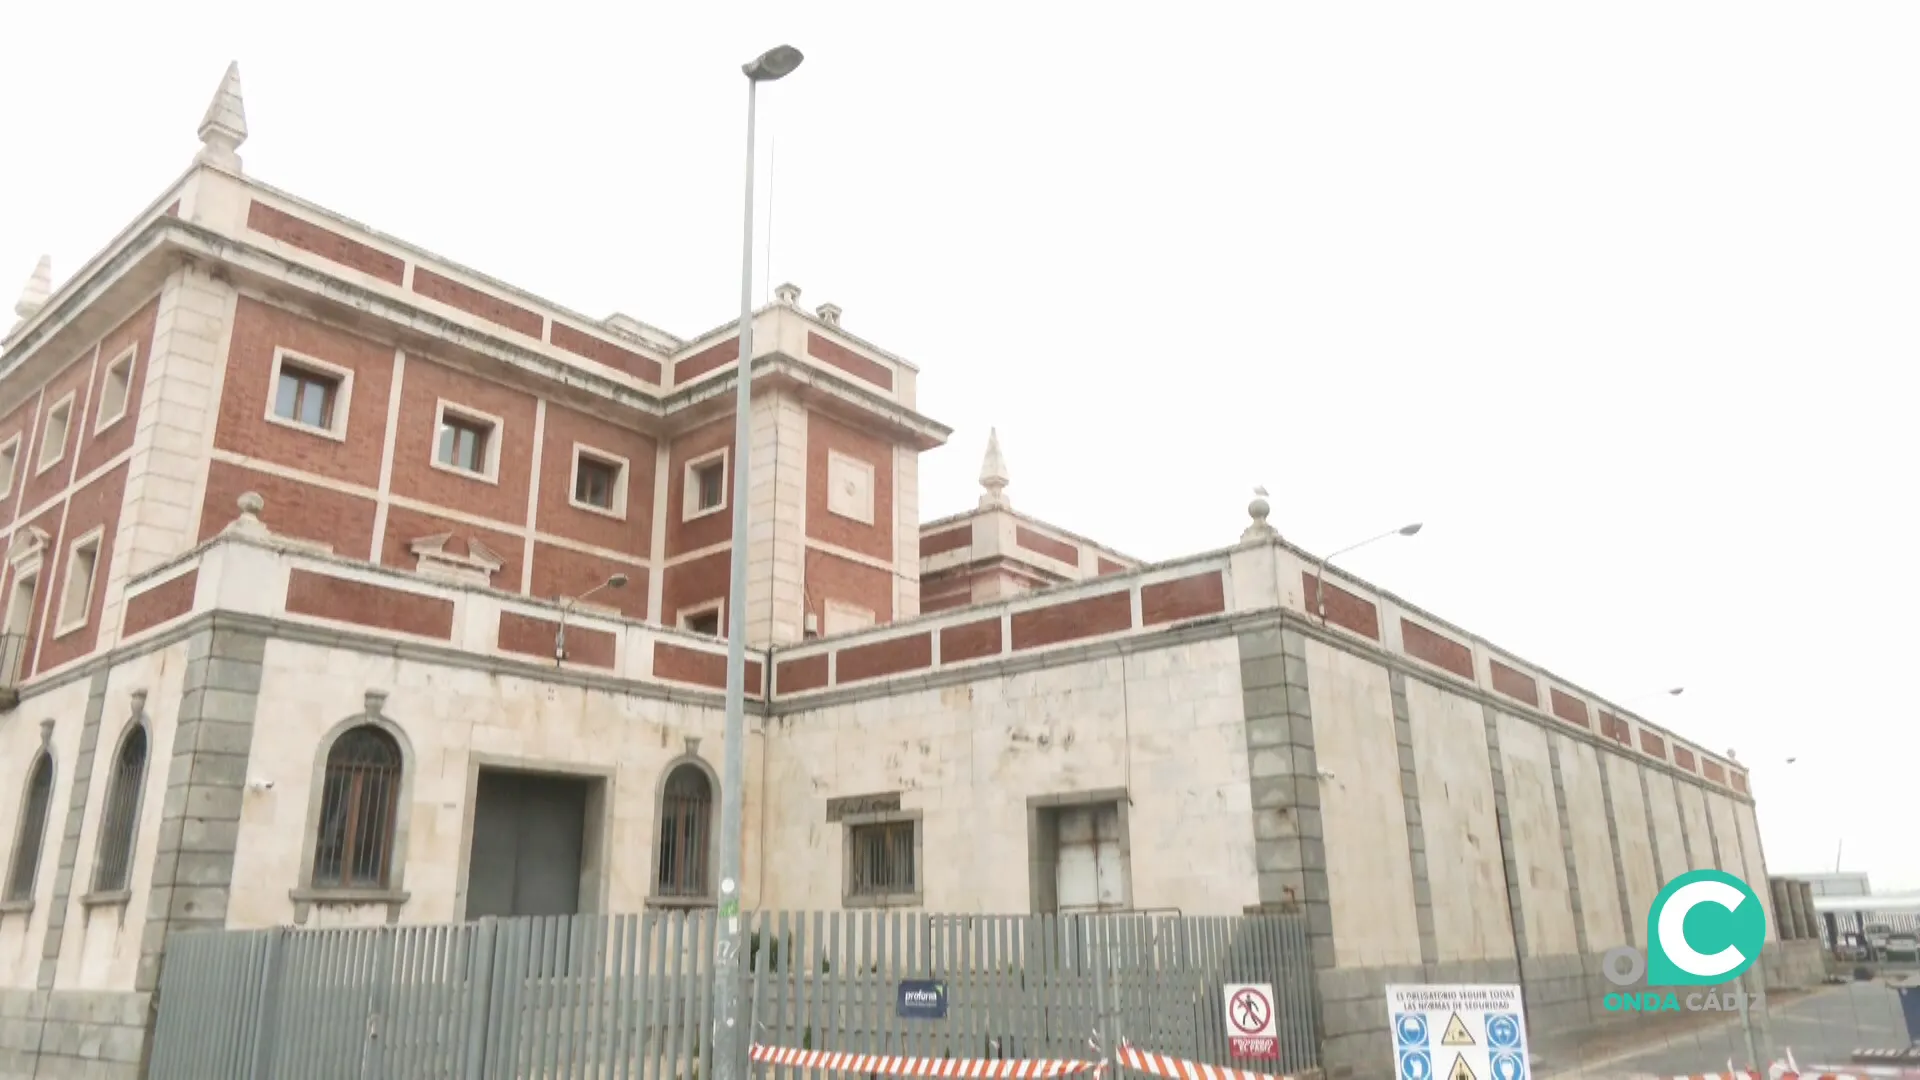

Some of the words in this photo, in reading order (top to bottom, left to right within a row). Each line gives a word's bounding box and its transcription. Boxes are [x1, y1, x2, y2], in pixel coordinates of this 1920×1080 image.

[1396, 992, 1404, 1000] ES
[1406, 991, 1456, 1000] OBLIGATORIO
[1459, 991, 1487, 999] SEGUIR
[1490, 989, 1515, 999] TODAS
[1404, 1002, 1416, 1010] LAS
[1419, 1002, 1451, 1010] NORMAS
[1453, 1002, 1463, 1010] DE
[1465, 1001, 1510, 1010] SEGURIDAD
